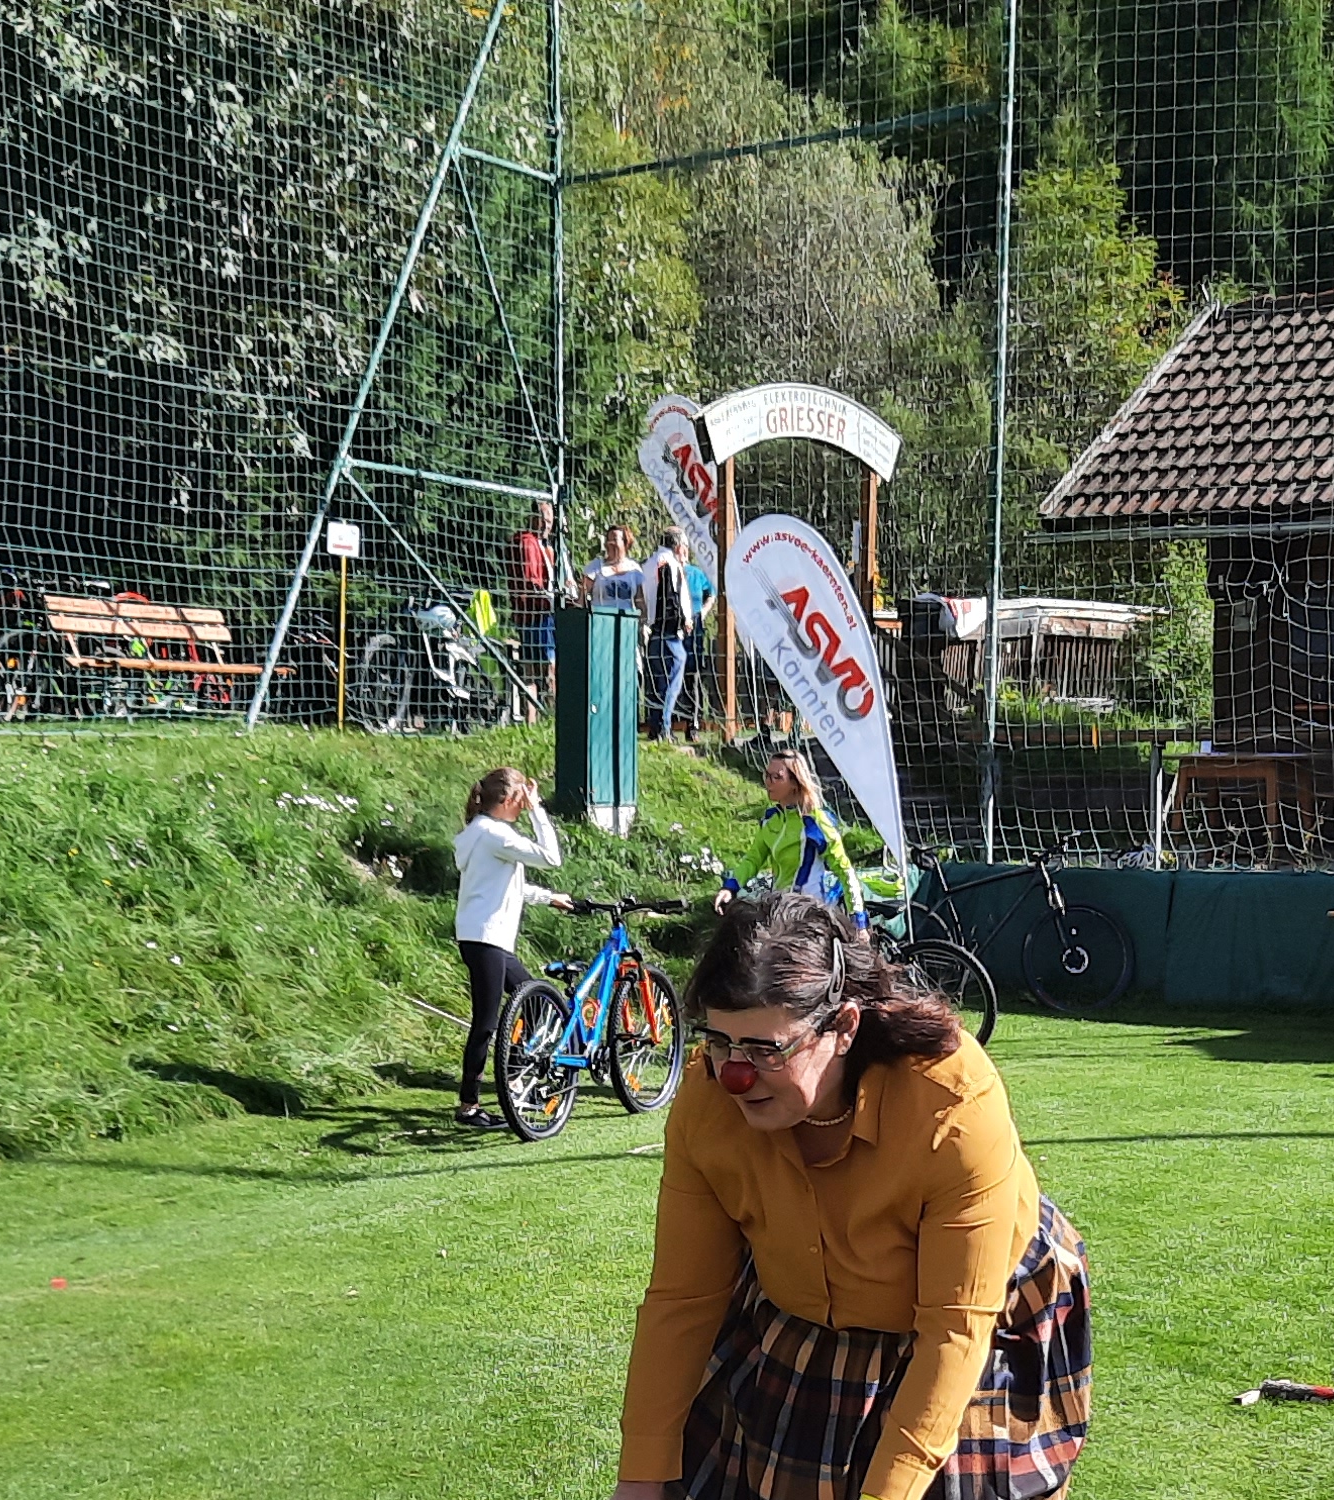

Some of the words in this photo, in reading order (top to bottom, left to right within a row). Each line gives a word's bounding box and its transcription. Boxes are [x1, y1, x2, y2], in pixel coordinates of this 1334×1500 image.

[766, 405, 847, 444] GRIESSER
[742, 531, 858, 631] www.asvoe-kaernten.at
[769, 636, 846, 747] Kärnten
